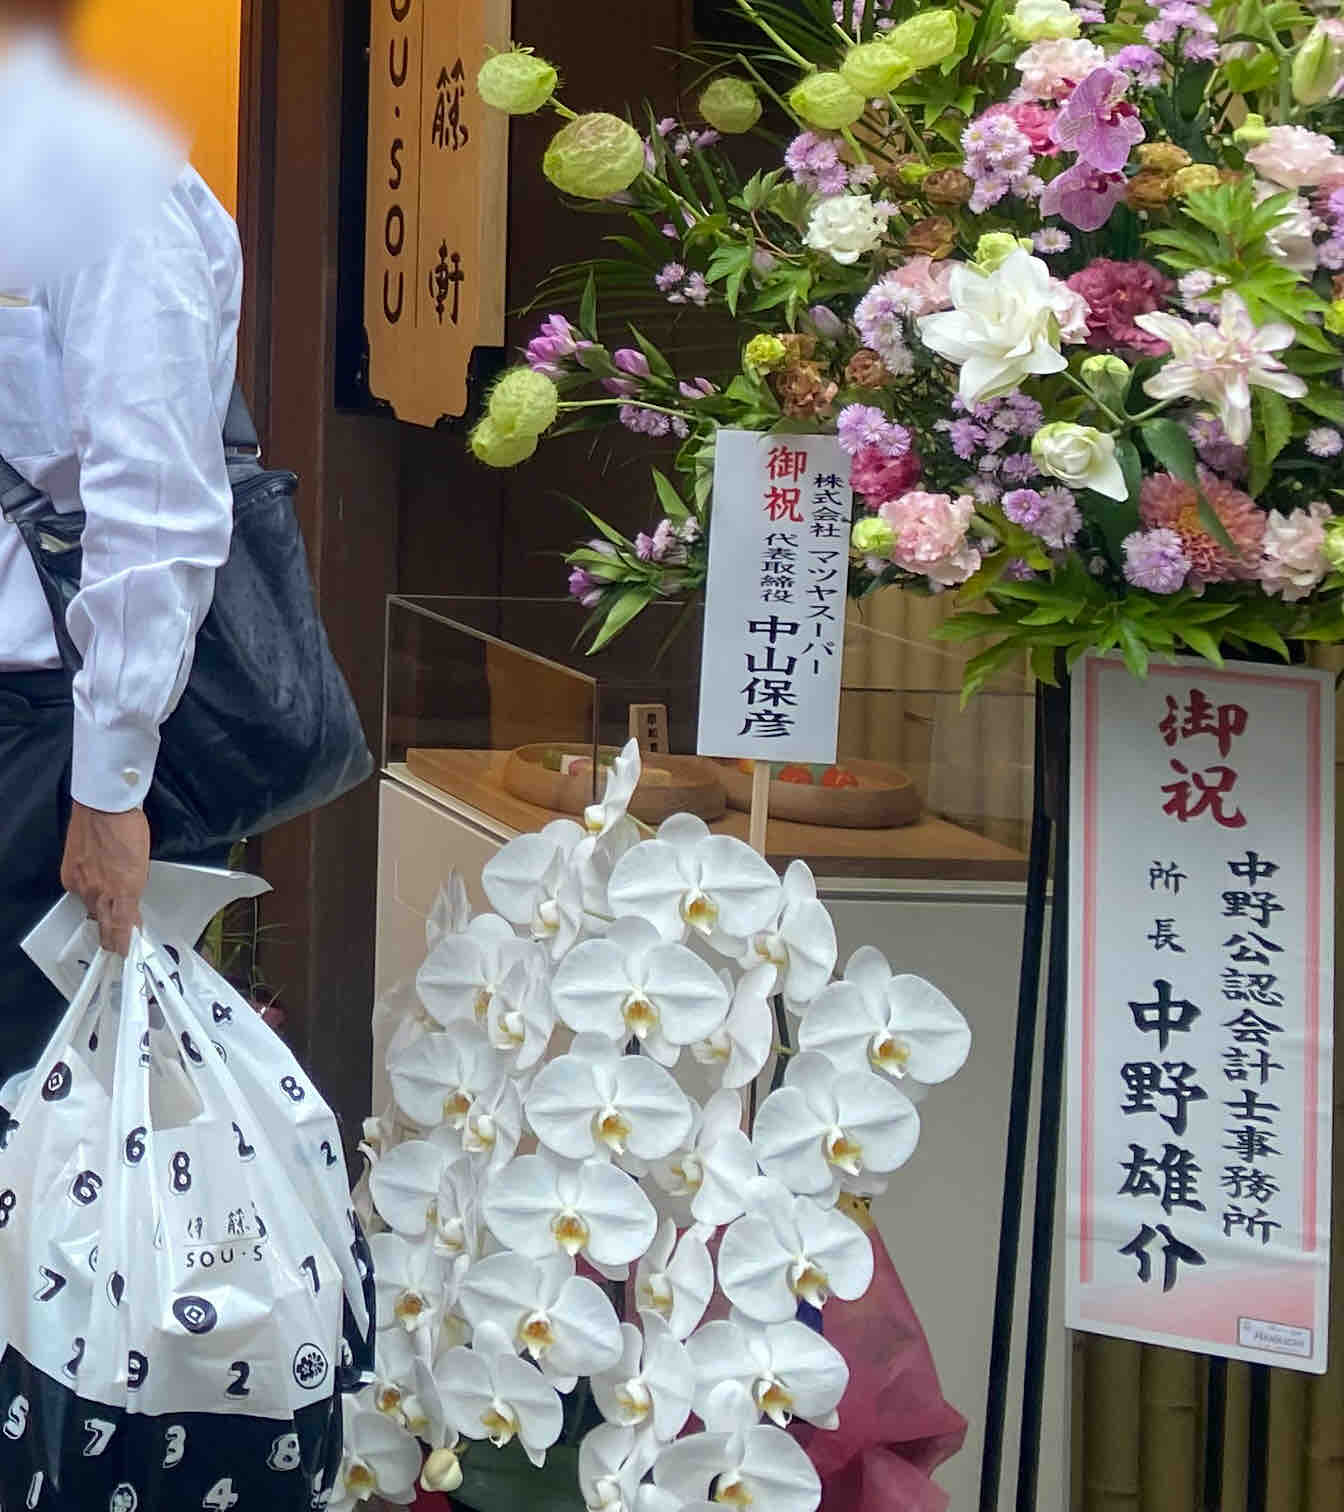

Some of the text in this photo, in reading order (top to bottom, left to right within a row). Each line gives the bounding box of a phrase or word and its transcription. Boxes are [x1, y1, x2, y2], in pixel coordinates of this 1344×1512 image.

[763, 445, 809, 524] 御祝
[801, 473, 845, 675] 株式会社 マツヤスーパー
[737, 532, 801, 739] 代表取締役 中山保彦
[1159, 688, 1250, 831] 御祝
[1147, 859, 1189, 956] 所長
[211, 1000, 233, 1023] 4
[1220, 849, 1286, 1247] 中野公認会計士事務所
[280, 1075, 305, 1102] 8
[124, 1126, 148, 1165] 6
[71, 1169, 104, 1206] 6
[172, 1151, 192, 1193] 8
[224, 1360, 251, 1400] 2
[2, 1394, 30, 1440] 5
[82, 1417, 117, 1457] 7
